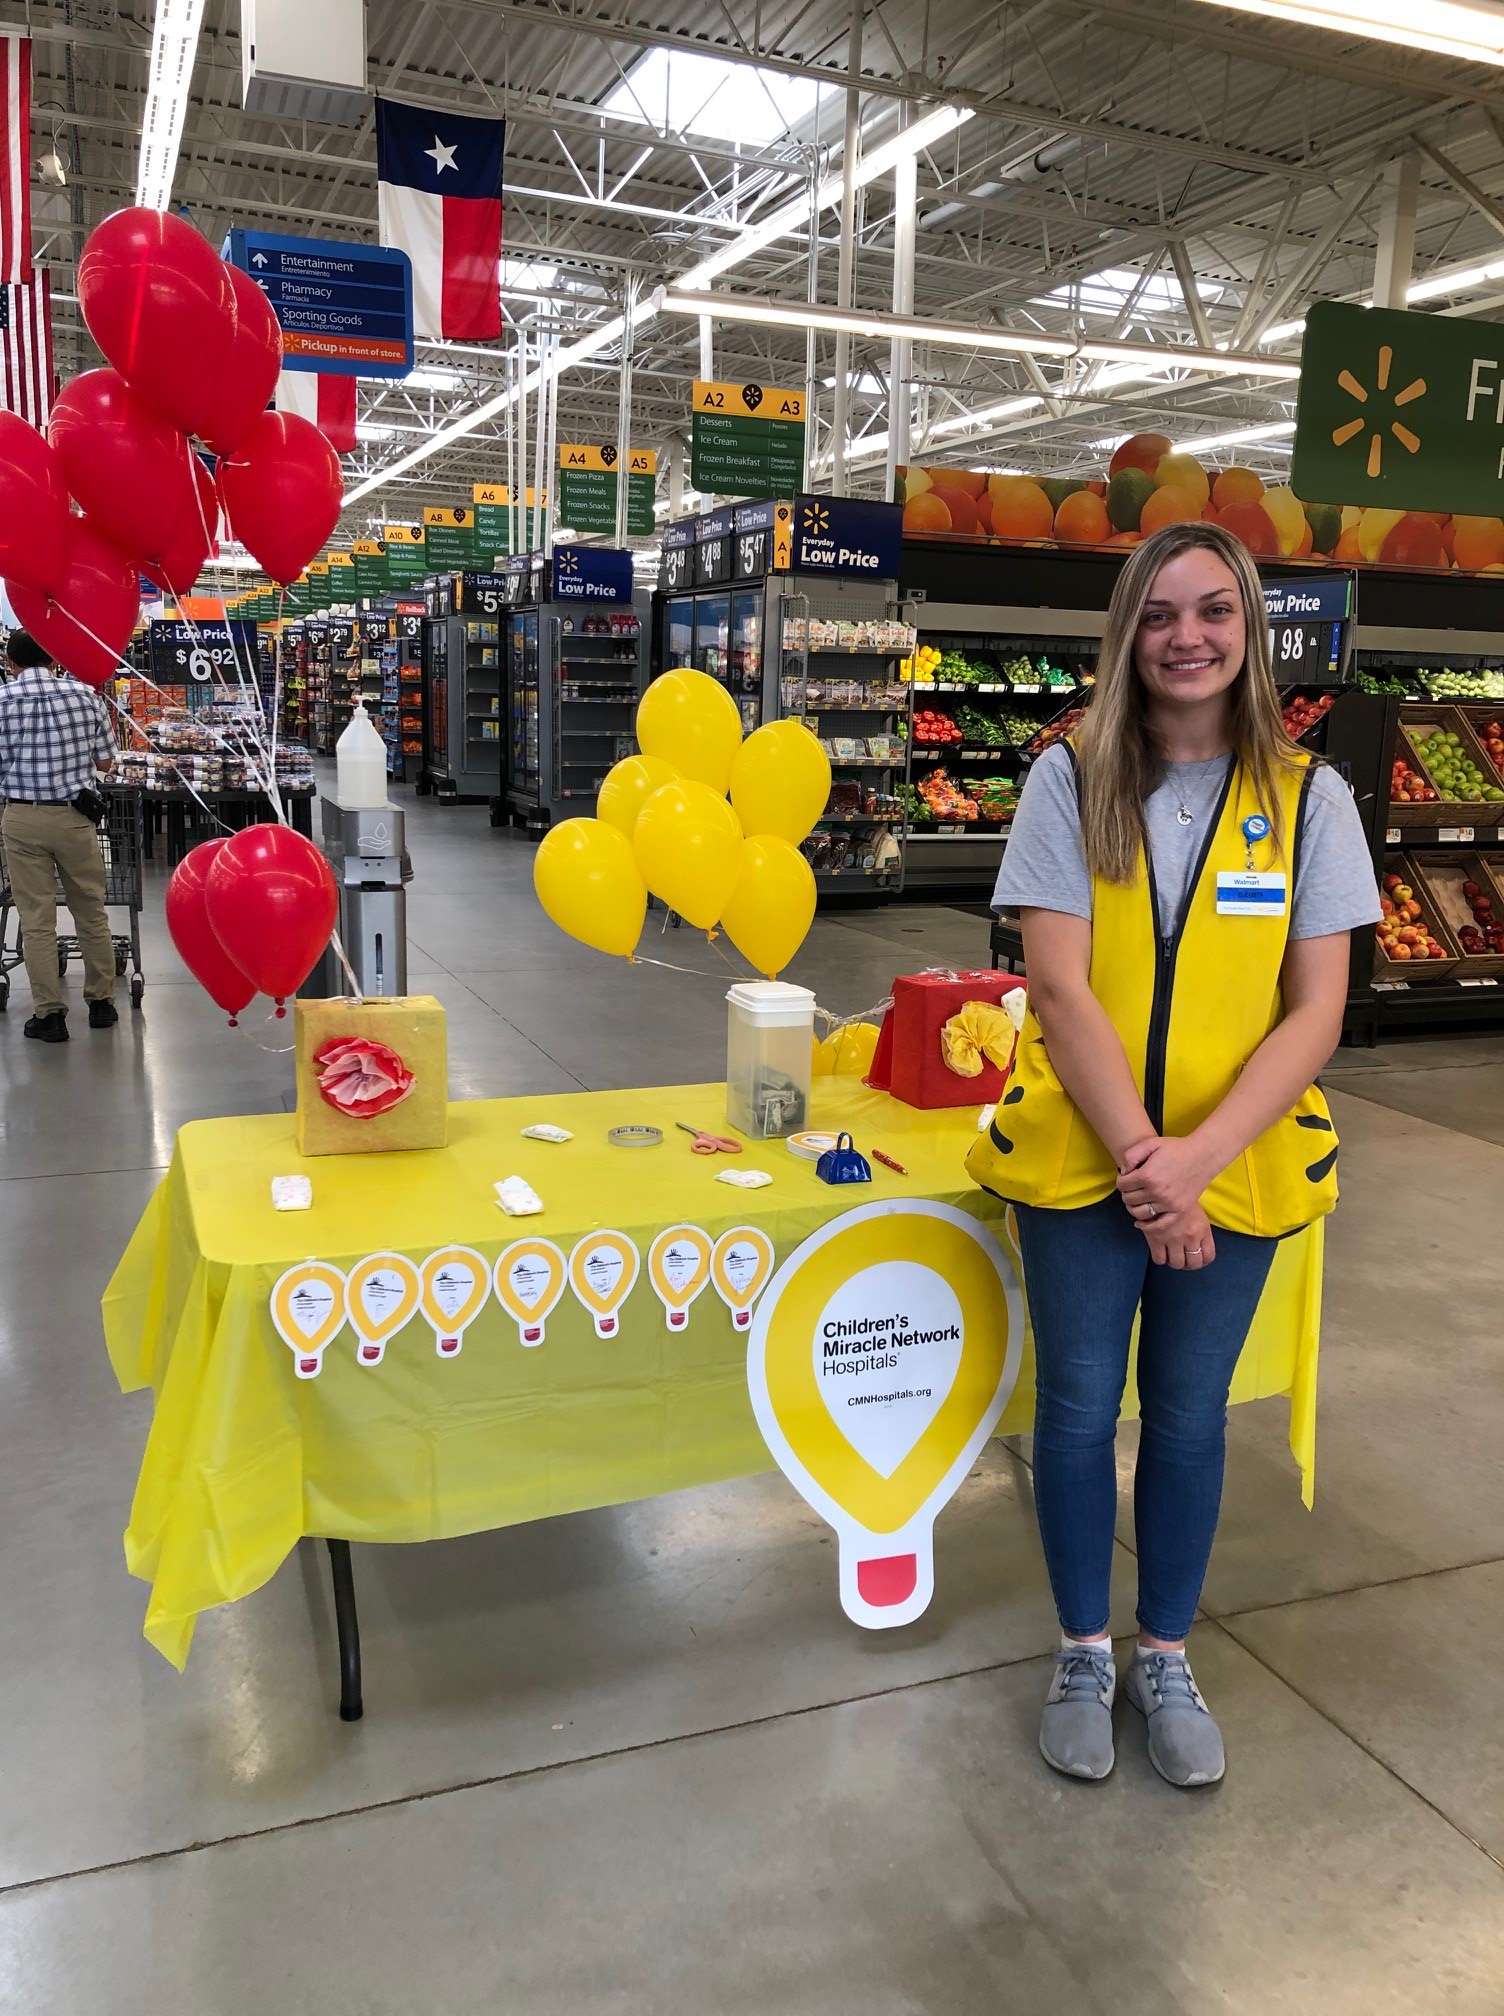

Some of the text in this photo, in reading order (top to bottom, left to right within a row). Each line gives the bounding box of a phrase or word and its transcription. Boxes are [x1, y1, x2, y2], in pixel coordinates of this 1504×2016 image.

[280, 254, 354, 273] Entertainment
[281, 266, 330, 278] Entretenimiento
[281, 282, 333, 299] Pharmacy
[282, 307, 363, 326] Sporting Goods
[301, 339, 403, 359] Pickup in front of store.
[703, 392, 800, 415] A2 A3
[700, 416, 733, 428] Desserts
[700, 435, 738, 447] Ice Cream
[568, 452, 648, 469] A4 A5
[699, 453, 761, 467] Frozen Breakfast
[566, 471, 605, 481] Frozen Pizza
[699, 473, 767, 486] Ice Cream Novelties
[481, 491, 495, 501] A6
[566, 486, 607, 496] Frozen Meals
[567, 501, 610, 510] Frozen Snacks
[430, 513, 443, 522] A8
[479, 518, 496, 526] Candy
[567, 515, 588, 523] Frozen
[741, 511, 767, 527] Low Price
[702, 521, 722, 535] Low Price
[388, 532, 403, 540] A10
[668, 530, 687, 543] Low Price
[802, 536, 834, 548] Everyday
[777, 541, 787, 552] A
[780, 556, 784, 566] 1
[801, 545, 879, 568] Low Price
[477, 577, 506, 586] Low Pri
[559, 574, 583, 583] Everyday
[558, 581, 616, 597] Low Price
[1261, 588, 1282, 596] veryday
[1265, 593, 1320, 613] ow Price
[176, 629, 233, 640] Low Pric
[823, 1314, 909, 1338] Children's
[824, 1325, 960, 1357] Miracle Network
[823, 1353, 898, 1376] Hospitals
[847, 1388, 932, 1406] CMNHospitals.org
